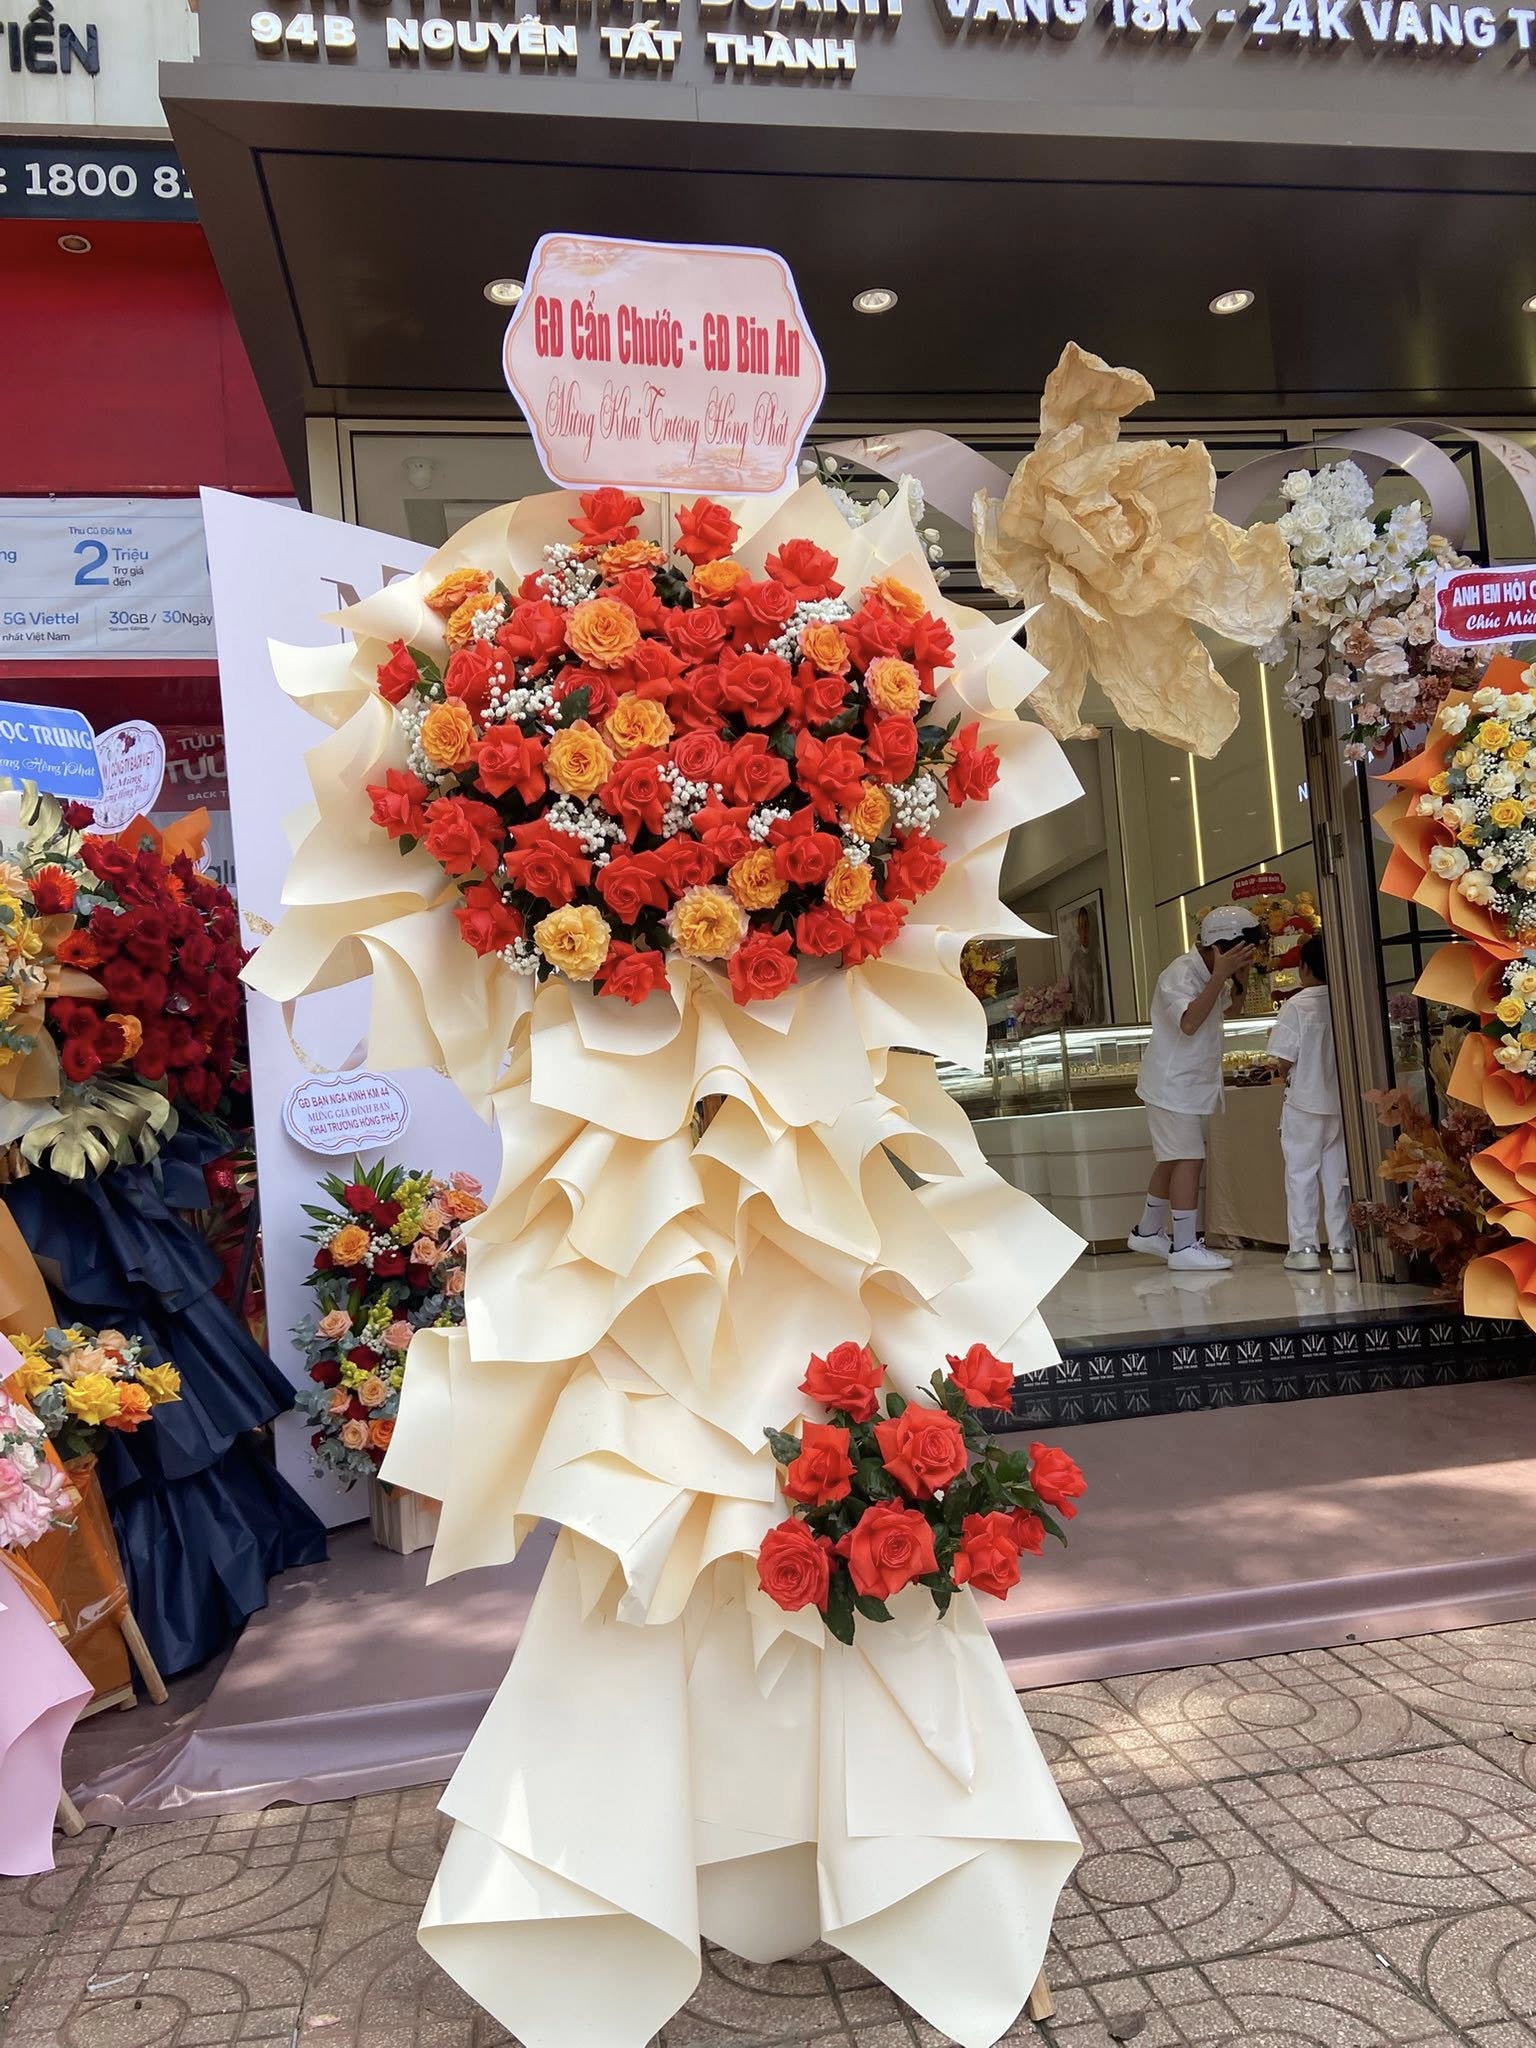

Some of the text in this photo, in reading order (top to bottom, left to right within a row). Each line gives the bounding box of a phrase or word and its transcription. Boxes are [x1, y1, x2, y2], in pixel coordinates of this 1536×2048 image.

[1251, 0, 1353, 39] 24K
[0, 0, 100, 75] IỀN
[250, 10, 857, 72] 94B NGUYỄN TẤT THÀNH
[25, 162, 138, 198] 1800
[534, 295, 564, 358] GĐ
[570, 290, 611, 362] Cẩn
[617, 303, 684, 369] Chước
[702, 312, 730, 371] GĐ
[736, 316, 769, 377] Bin
[775, 319, 801, 378] An
[599, 378, 641, 441] Khai
[752, 390, 789, 447] Phát
[68, 526, 85, 536] Thu
[74, 539, 111, 586] 2
[112, 547, 149, 563] Triệu
[112, 565, 144, 577] Trợ giá
[112, 577, 132, 587] đến
[1452, 585, 1480, 608] ANH
[1482, 583, 1501, 605] EM
[1502, 577, 1527, 605] HỘI
[3, 612, 79, 625] 5G Viettel
[108, 610, 149, 624] 30GB
[161, 609, 214, 627] 30Ngày
[1465, 611, 1501, 631] Chúc
[2, 631, 71, 642] nhất Việt Nam
[0, 719, 93, 751] ỌC TRUNG
[187, 790, 218, 801] BACK
[329, 1093, 348, 1105] NGA
[367, 1087, 380, 1099] KM
[380, 1087, 390, 1097] 44
[334, 1108, 350, 1119] GIA
[309, 1123, 328, 1134] KHAI
